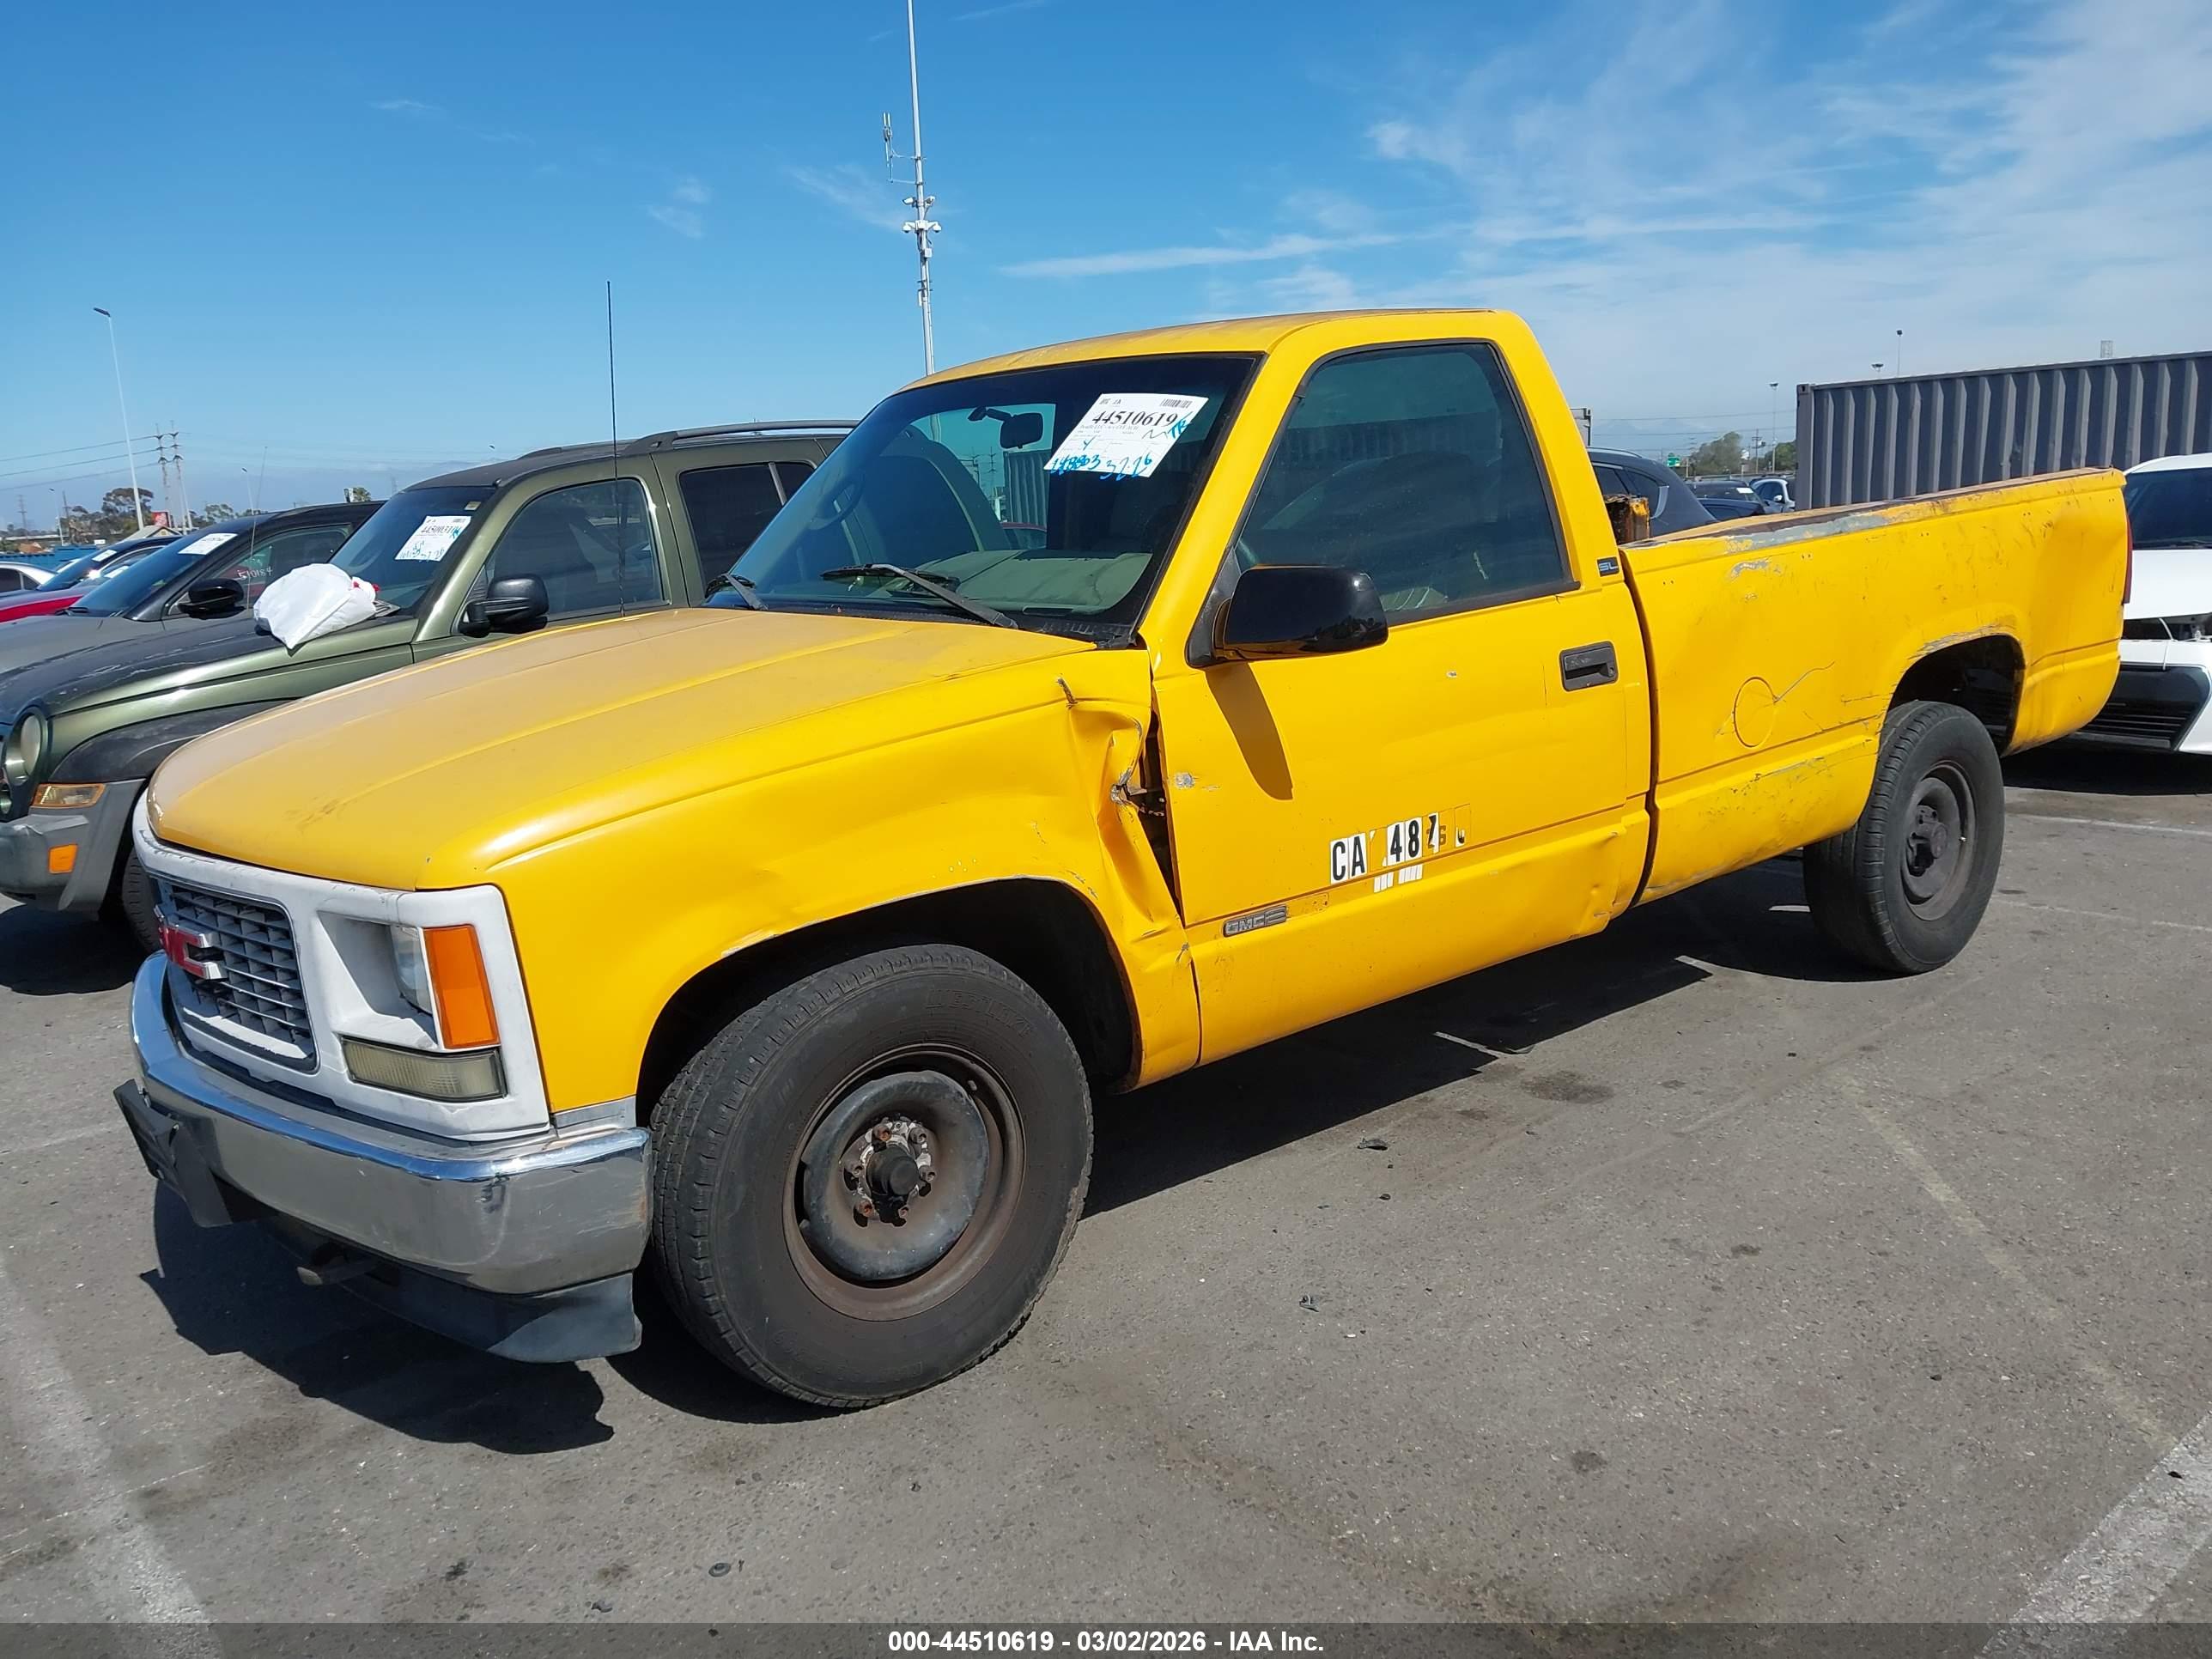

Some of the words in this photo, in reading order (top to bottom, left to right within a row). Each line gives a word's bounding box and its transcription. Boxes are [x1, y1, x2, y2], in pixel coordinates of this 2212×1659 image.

[1092, 410, 1177, 427] 44510619
[1332, 836, 1366, 881] CA
[1225, 914, 1265, 936] GMC
